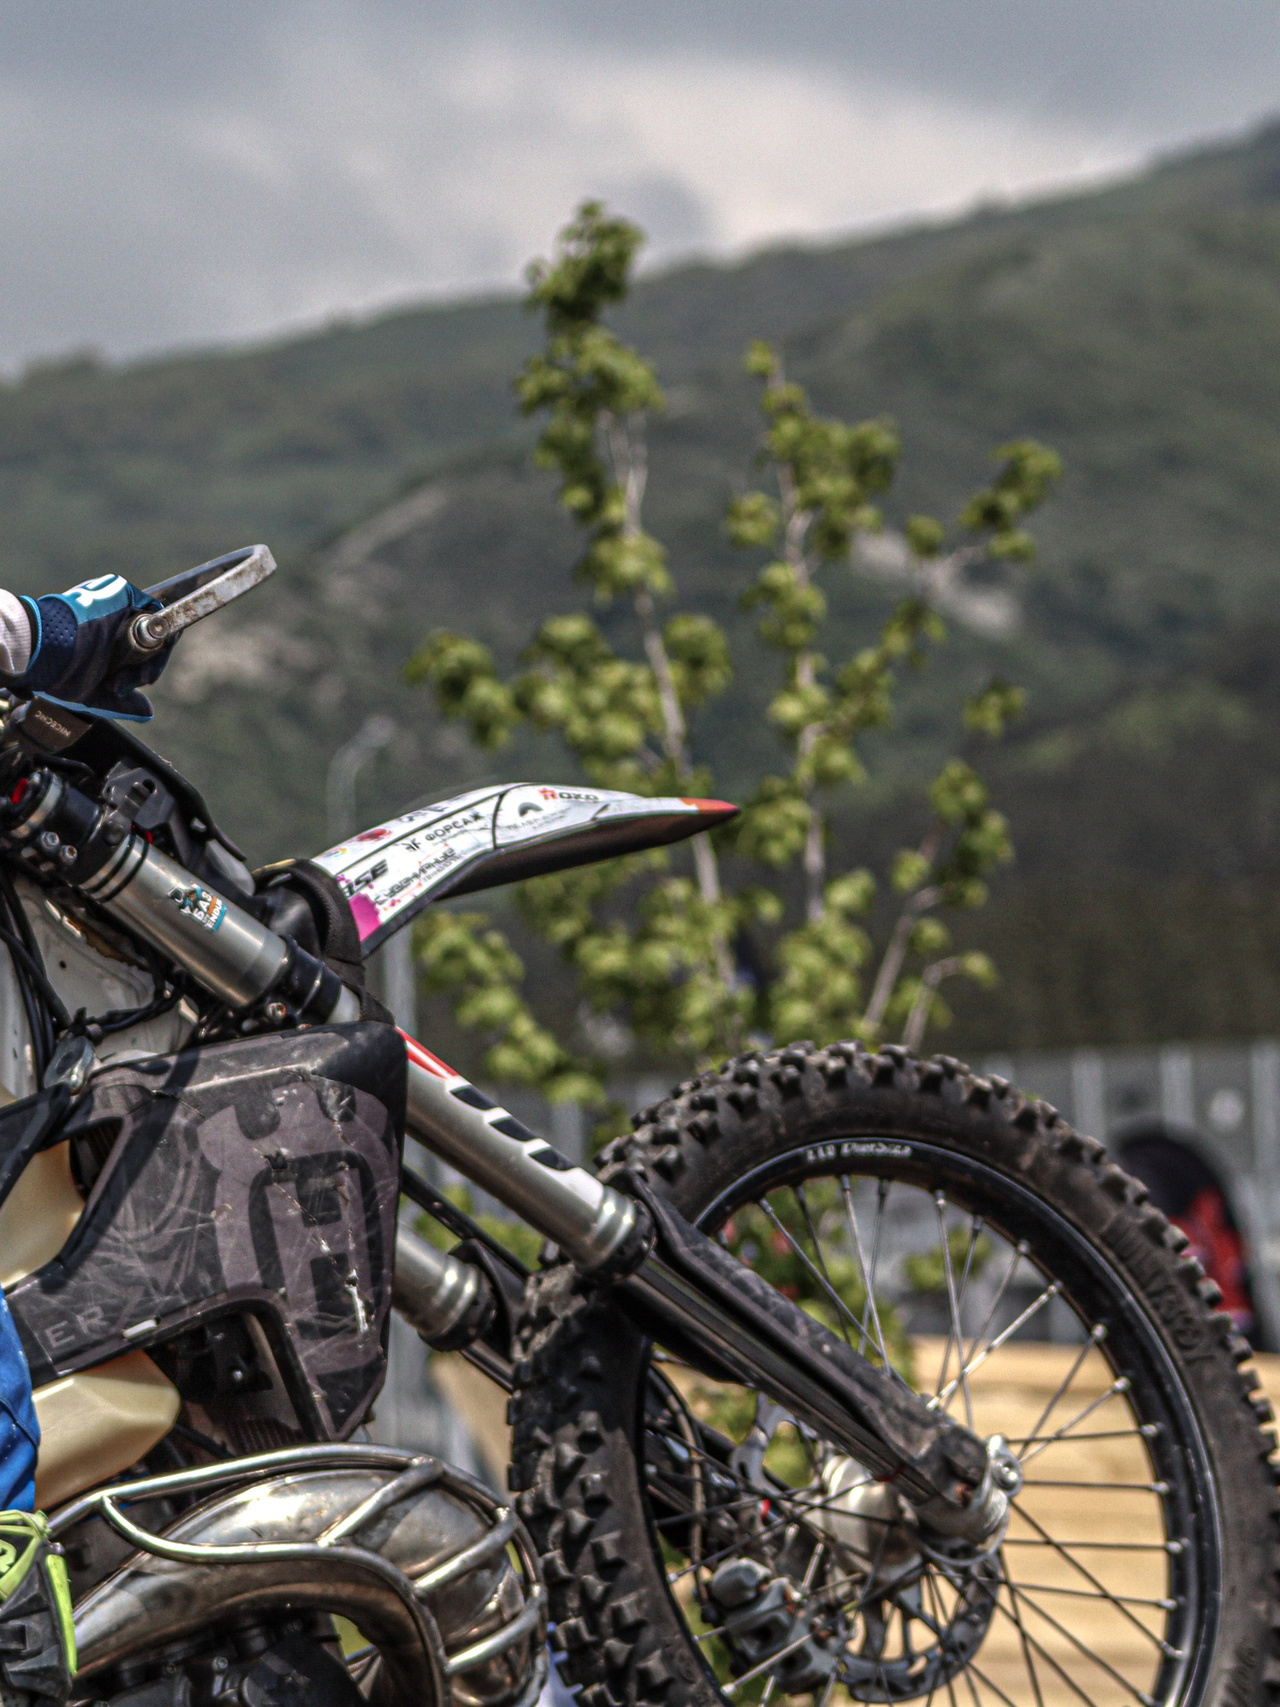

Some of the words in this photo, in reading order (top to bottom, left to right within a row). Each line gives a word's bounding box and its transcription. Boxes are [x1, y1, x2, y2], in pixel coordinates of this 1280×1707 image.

[34, 709, 72, 738] NICECNC
[424, 809, 487, 843] ФОРСАЖ
[193, 890, 213, 922] БАЗ
